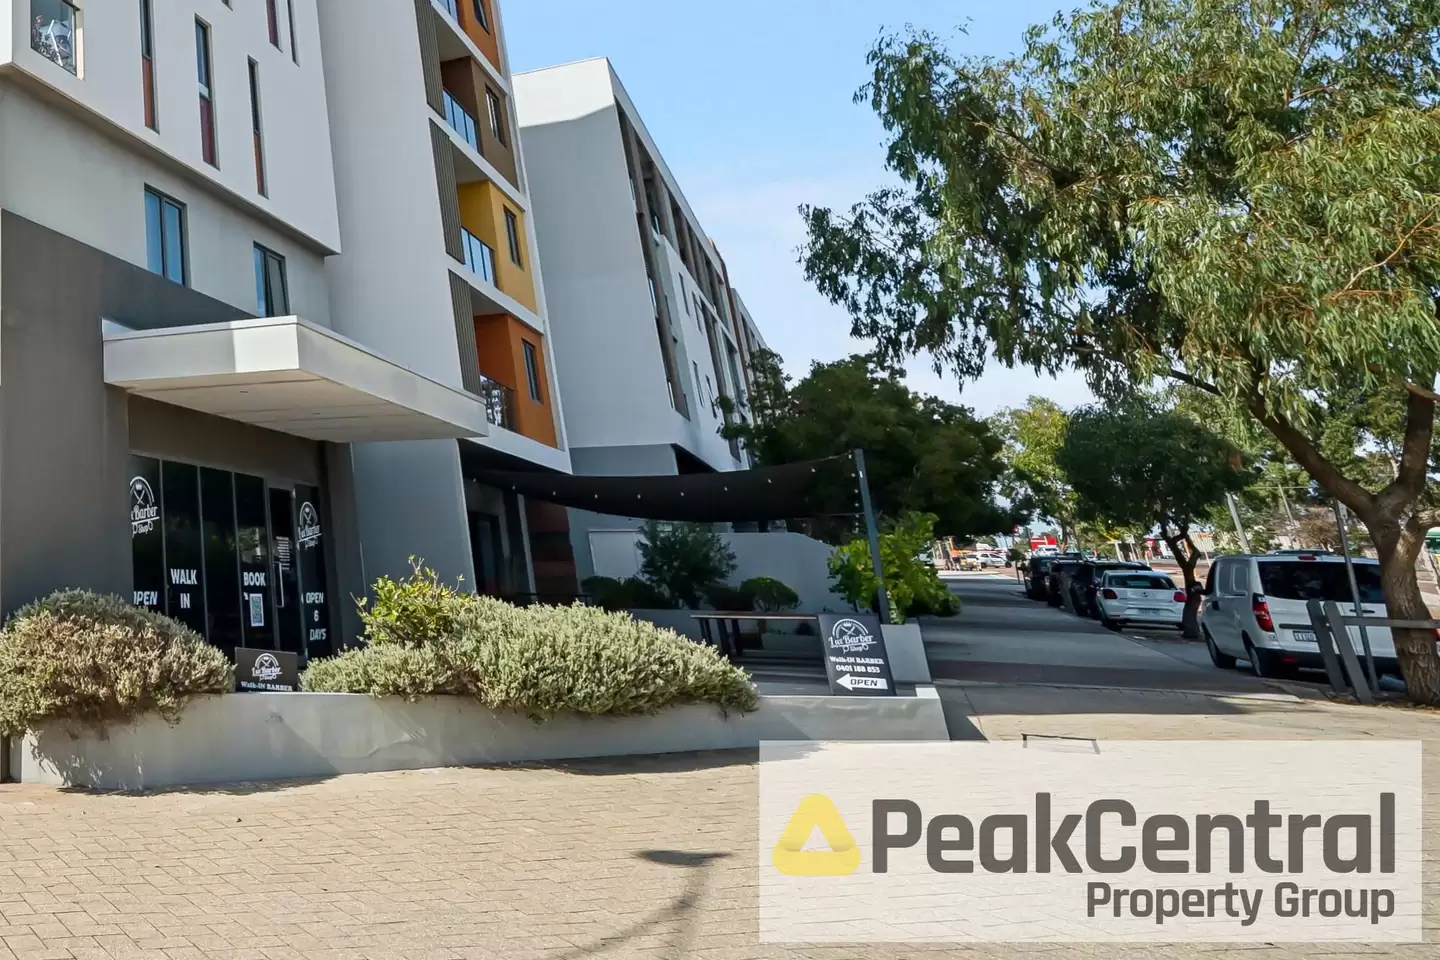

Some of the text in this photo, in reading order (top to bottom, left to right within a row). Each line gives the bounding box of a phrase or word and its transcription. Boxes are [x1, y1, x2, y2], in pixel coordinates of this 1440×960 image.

[170, 568, 198, 585] WALK
[243, 572, 266, 586] BOOK
[180, 593, 191, 609] IN
[305, 592, 324, 604] OPEN
[313, 609, 319, 622] 6
[309, 628, 327, 641] DAYS
[842, 633, 873, 645] Barber
[856, 656, 885, 665] BARBER
[850, 678, 878, 687] OPEN
